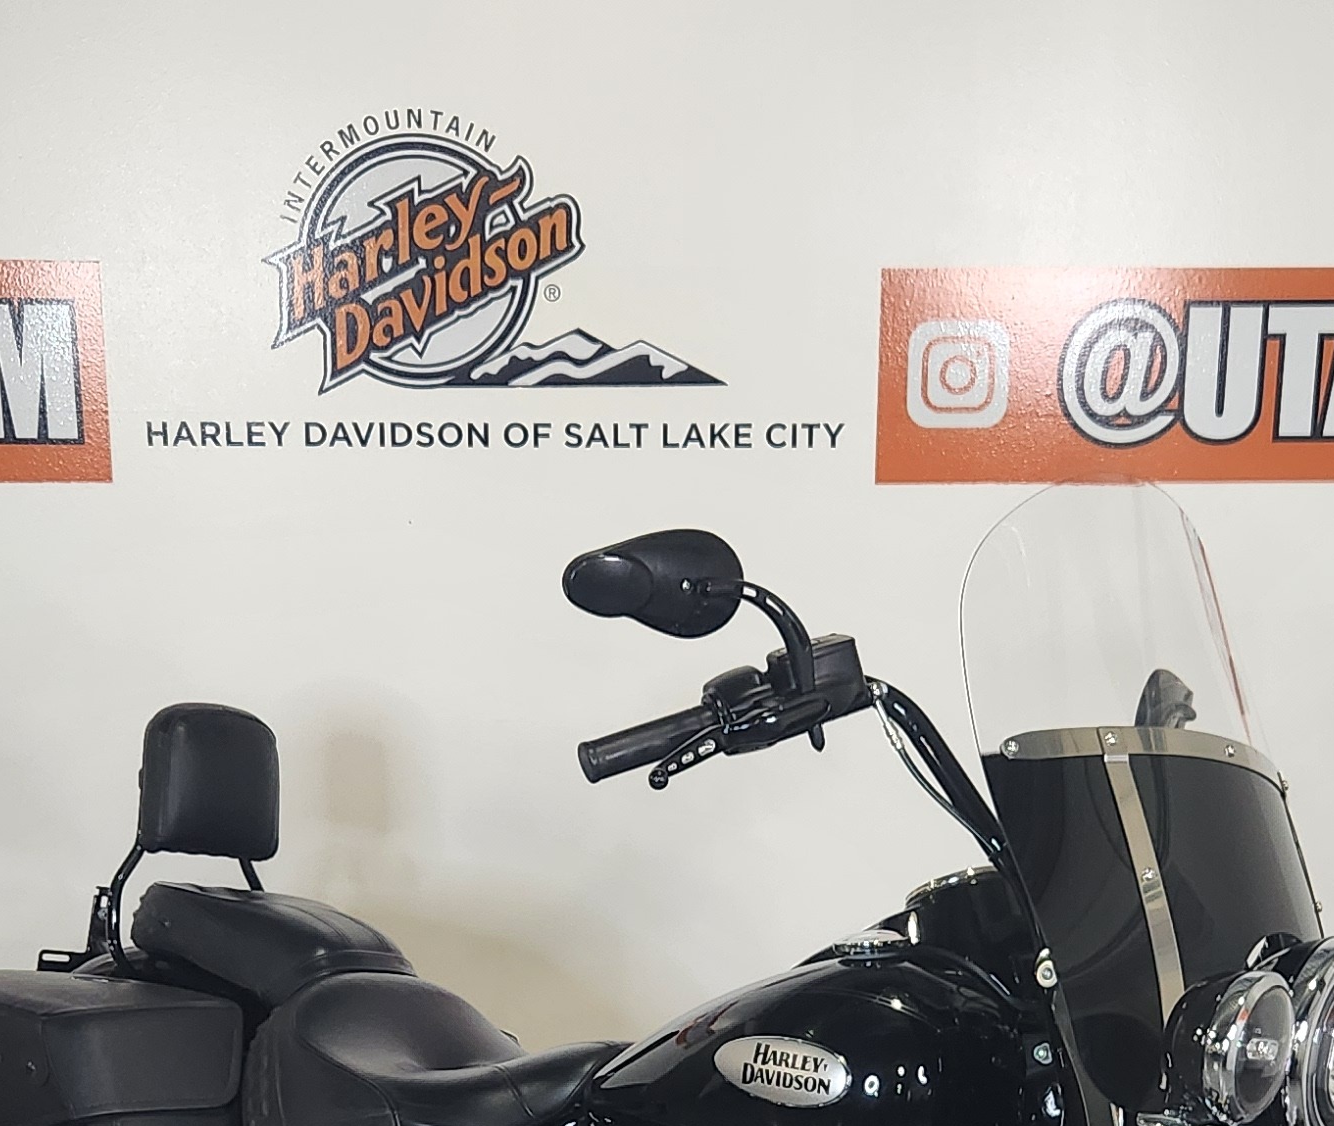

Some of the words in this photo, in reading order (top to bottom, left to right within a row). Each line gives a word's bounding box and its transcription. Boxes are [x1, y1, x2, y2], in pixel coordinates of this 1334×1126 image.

[280, 108, 497, 224] INTERMOUNTAIN
[334, 207, 568, 371] Davidson
[146, 421, 291, 447] HARLEY
[304, 422, 490, 448] DAVIDSON
[503, 422, 552, 448] OF
[564, 422, 650, 448] SALT
[663, 422, 753, 448] LAKE
[766, 422, 846, 448] CITY
[741, 1062, 831, 1096] DAVIDSON
